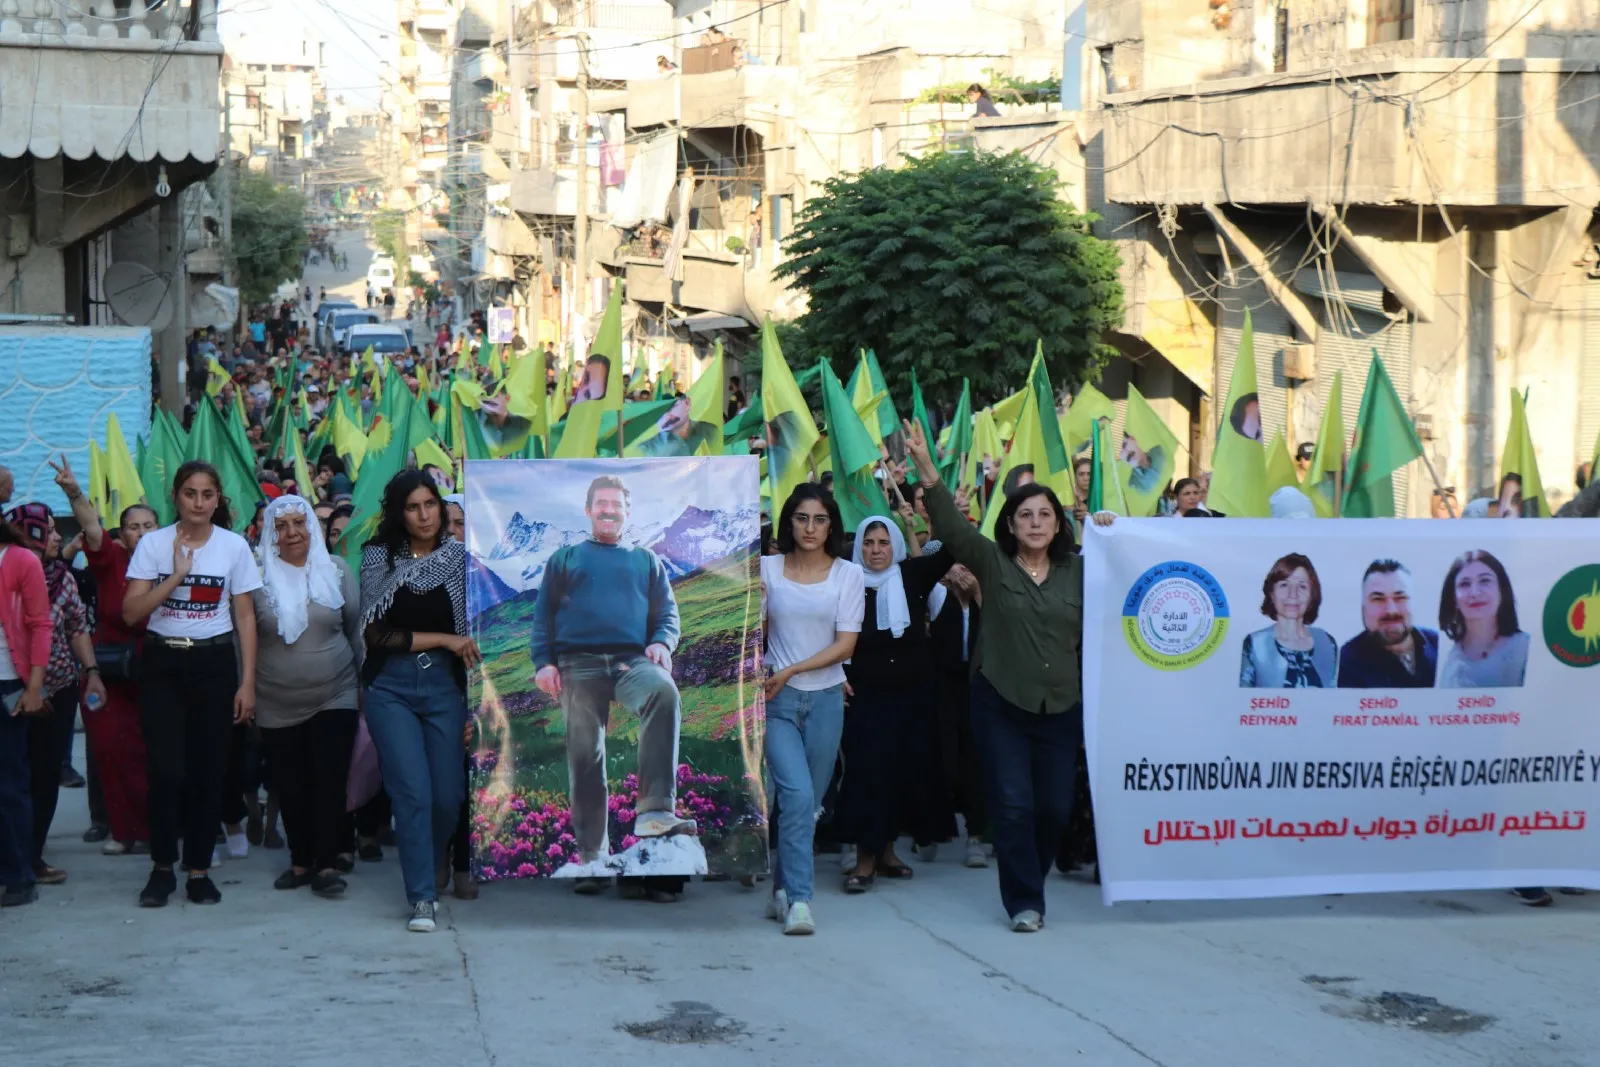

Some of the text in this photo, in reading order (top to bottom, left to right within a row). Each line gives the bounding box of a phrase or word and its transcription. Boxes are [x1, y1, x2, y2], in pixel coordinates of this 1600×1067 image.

[159, 576, 223, 587] TMMY
[1240, 714, 1298, 726] REIYHAN
[1333, 715, 1368, 726] FIRAT
[1428, 714, 1470, 726] YUSRA
[1124, 756, 1262, 791] RÊXSTINBÛNA
[1266, 761, 1298, 788] JIN
[1303, 761, 1384, 789] BERSIVA
[1390, 753, 1457, 795] ÊRÎŞÊN
[1461, 749, 1585, 786] DAGIRKERIYÊ
[1143, 808, 1586, 847] تنظيم المرأة جواب لهجمات الإحتلال
